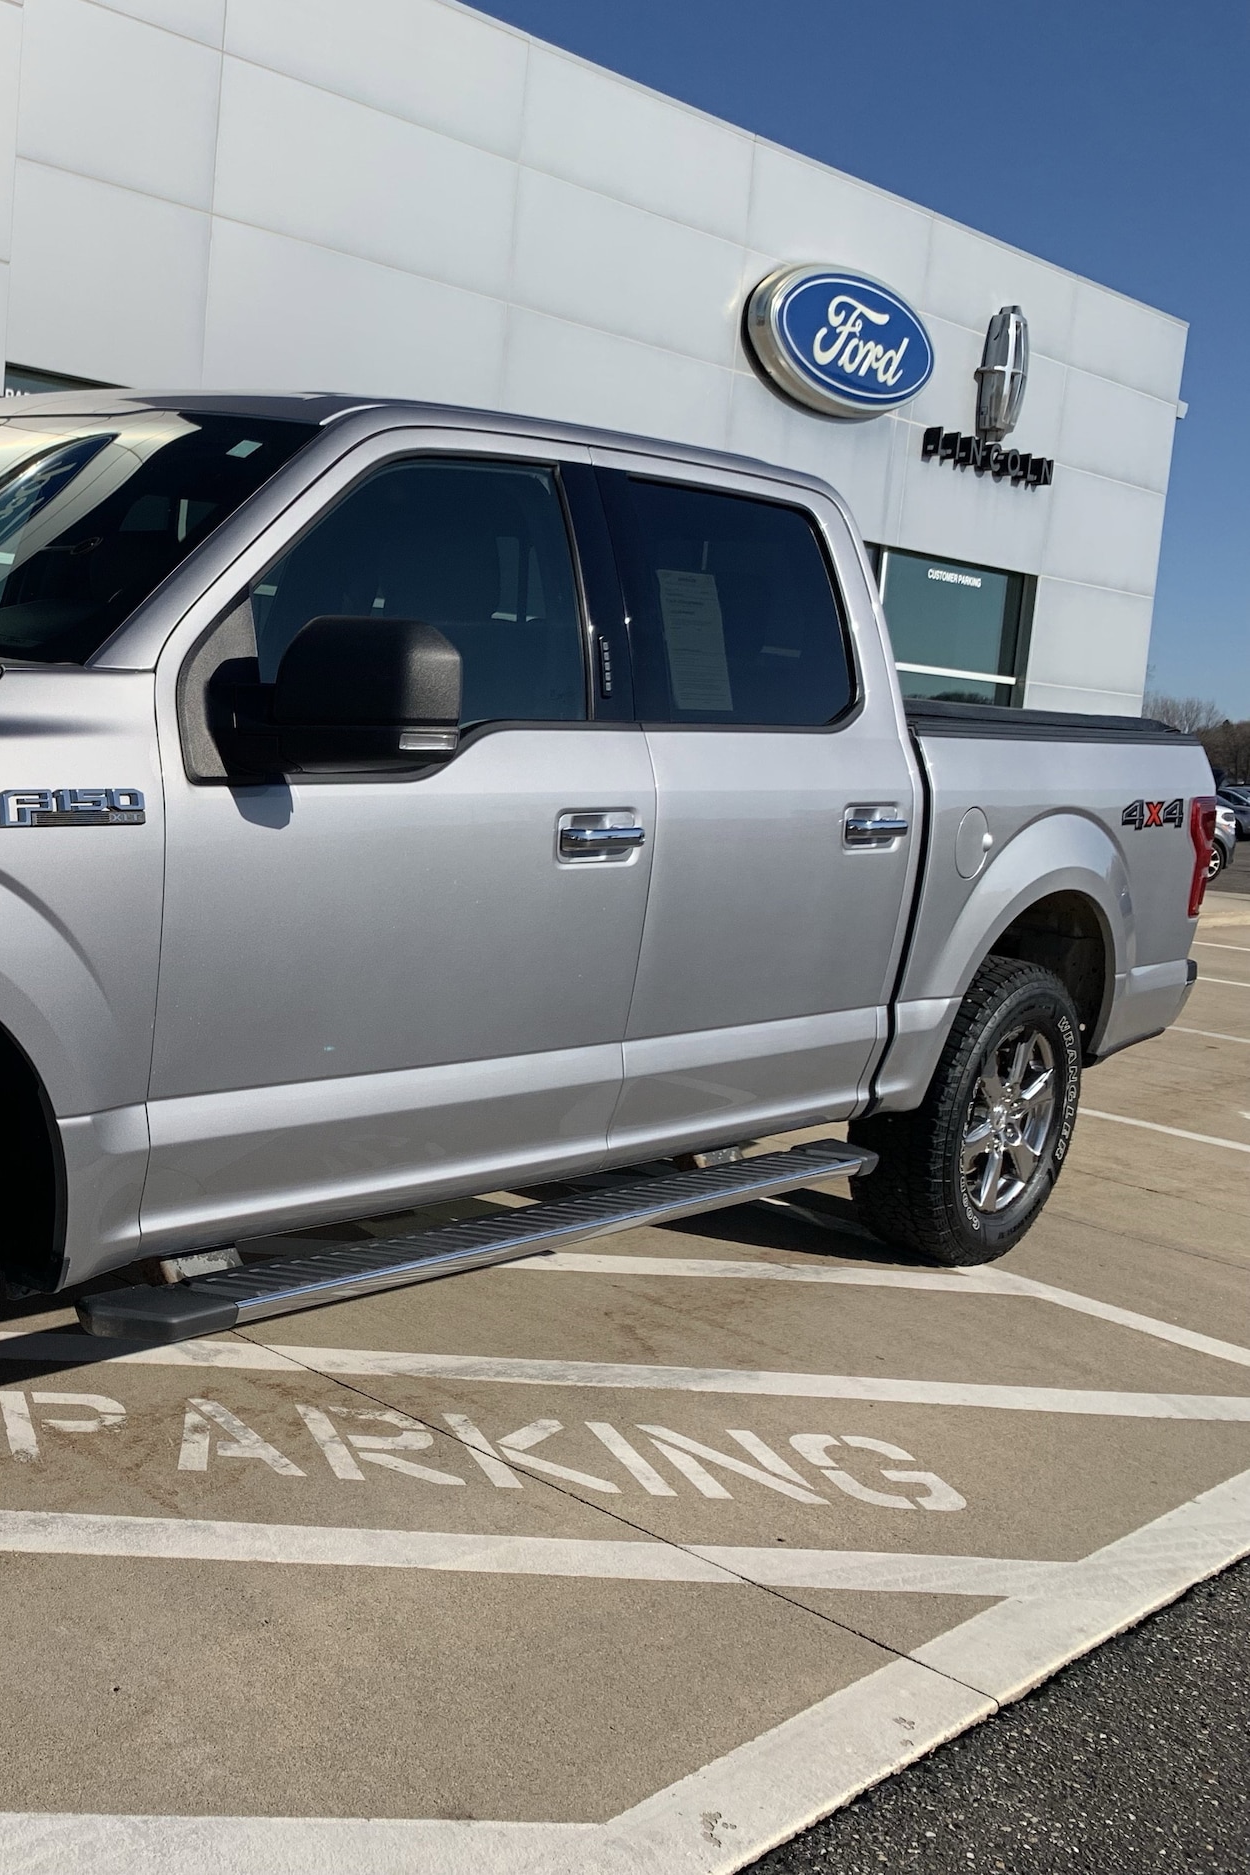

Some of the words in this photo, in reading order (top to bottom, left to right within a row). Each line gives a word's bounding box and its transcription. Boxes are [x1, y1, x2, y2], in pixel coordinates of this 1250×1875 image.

[813, 295, 909, 386] Ford
[927, 568, 958, 584] CUSTOMER
[958, 574, 982, 588] PARKING
[111, 812, 141, 822] XLT
[1057, 1015, 1078, 1161] WRANGLER
